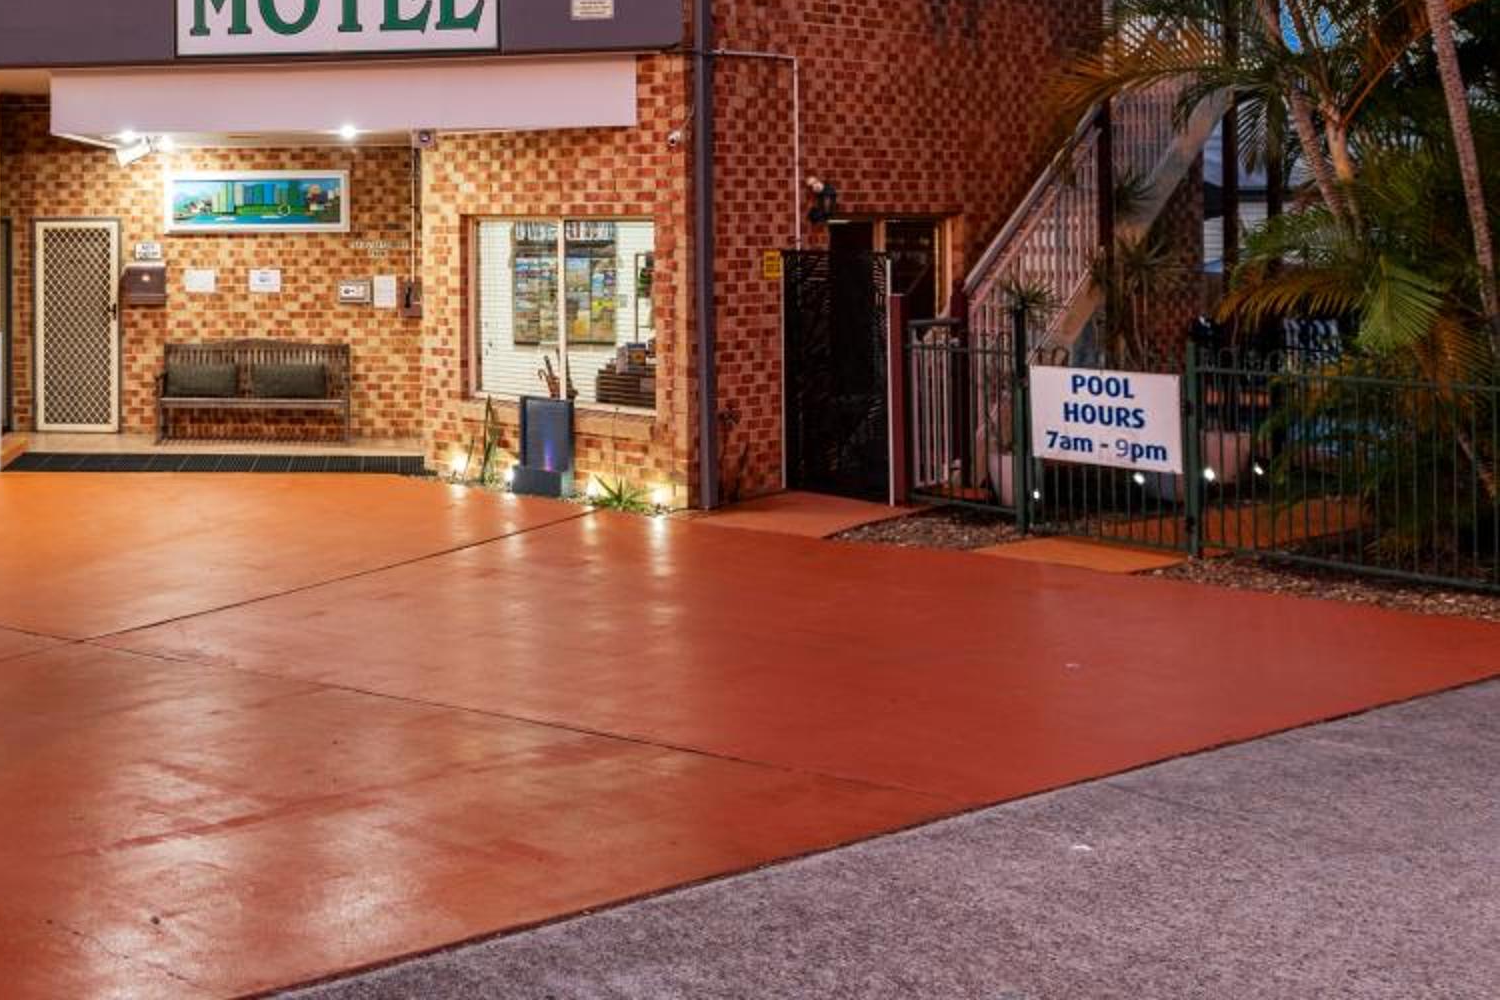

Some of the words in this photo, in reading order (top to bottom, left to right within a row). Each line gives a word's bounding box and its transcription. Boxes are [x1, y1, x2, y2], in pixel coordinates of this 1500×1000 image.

[1071, 374, 1135, 399] POOL
[1063, 402, 1145, 428] HOURS
[1045, 430, 1093, 453] 7am
[1115, 438, 1168, 463] 9pm
